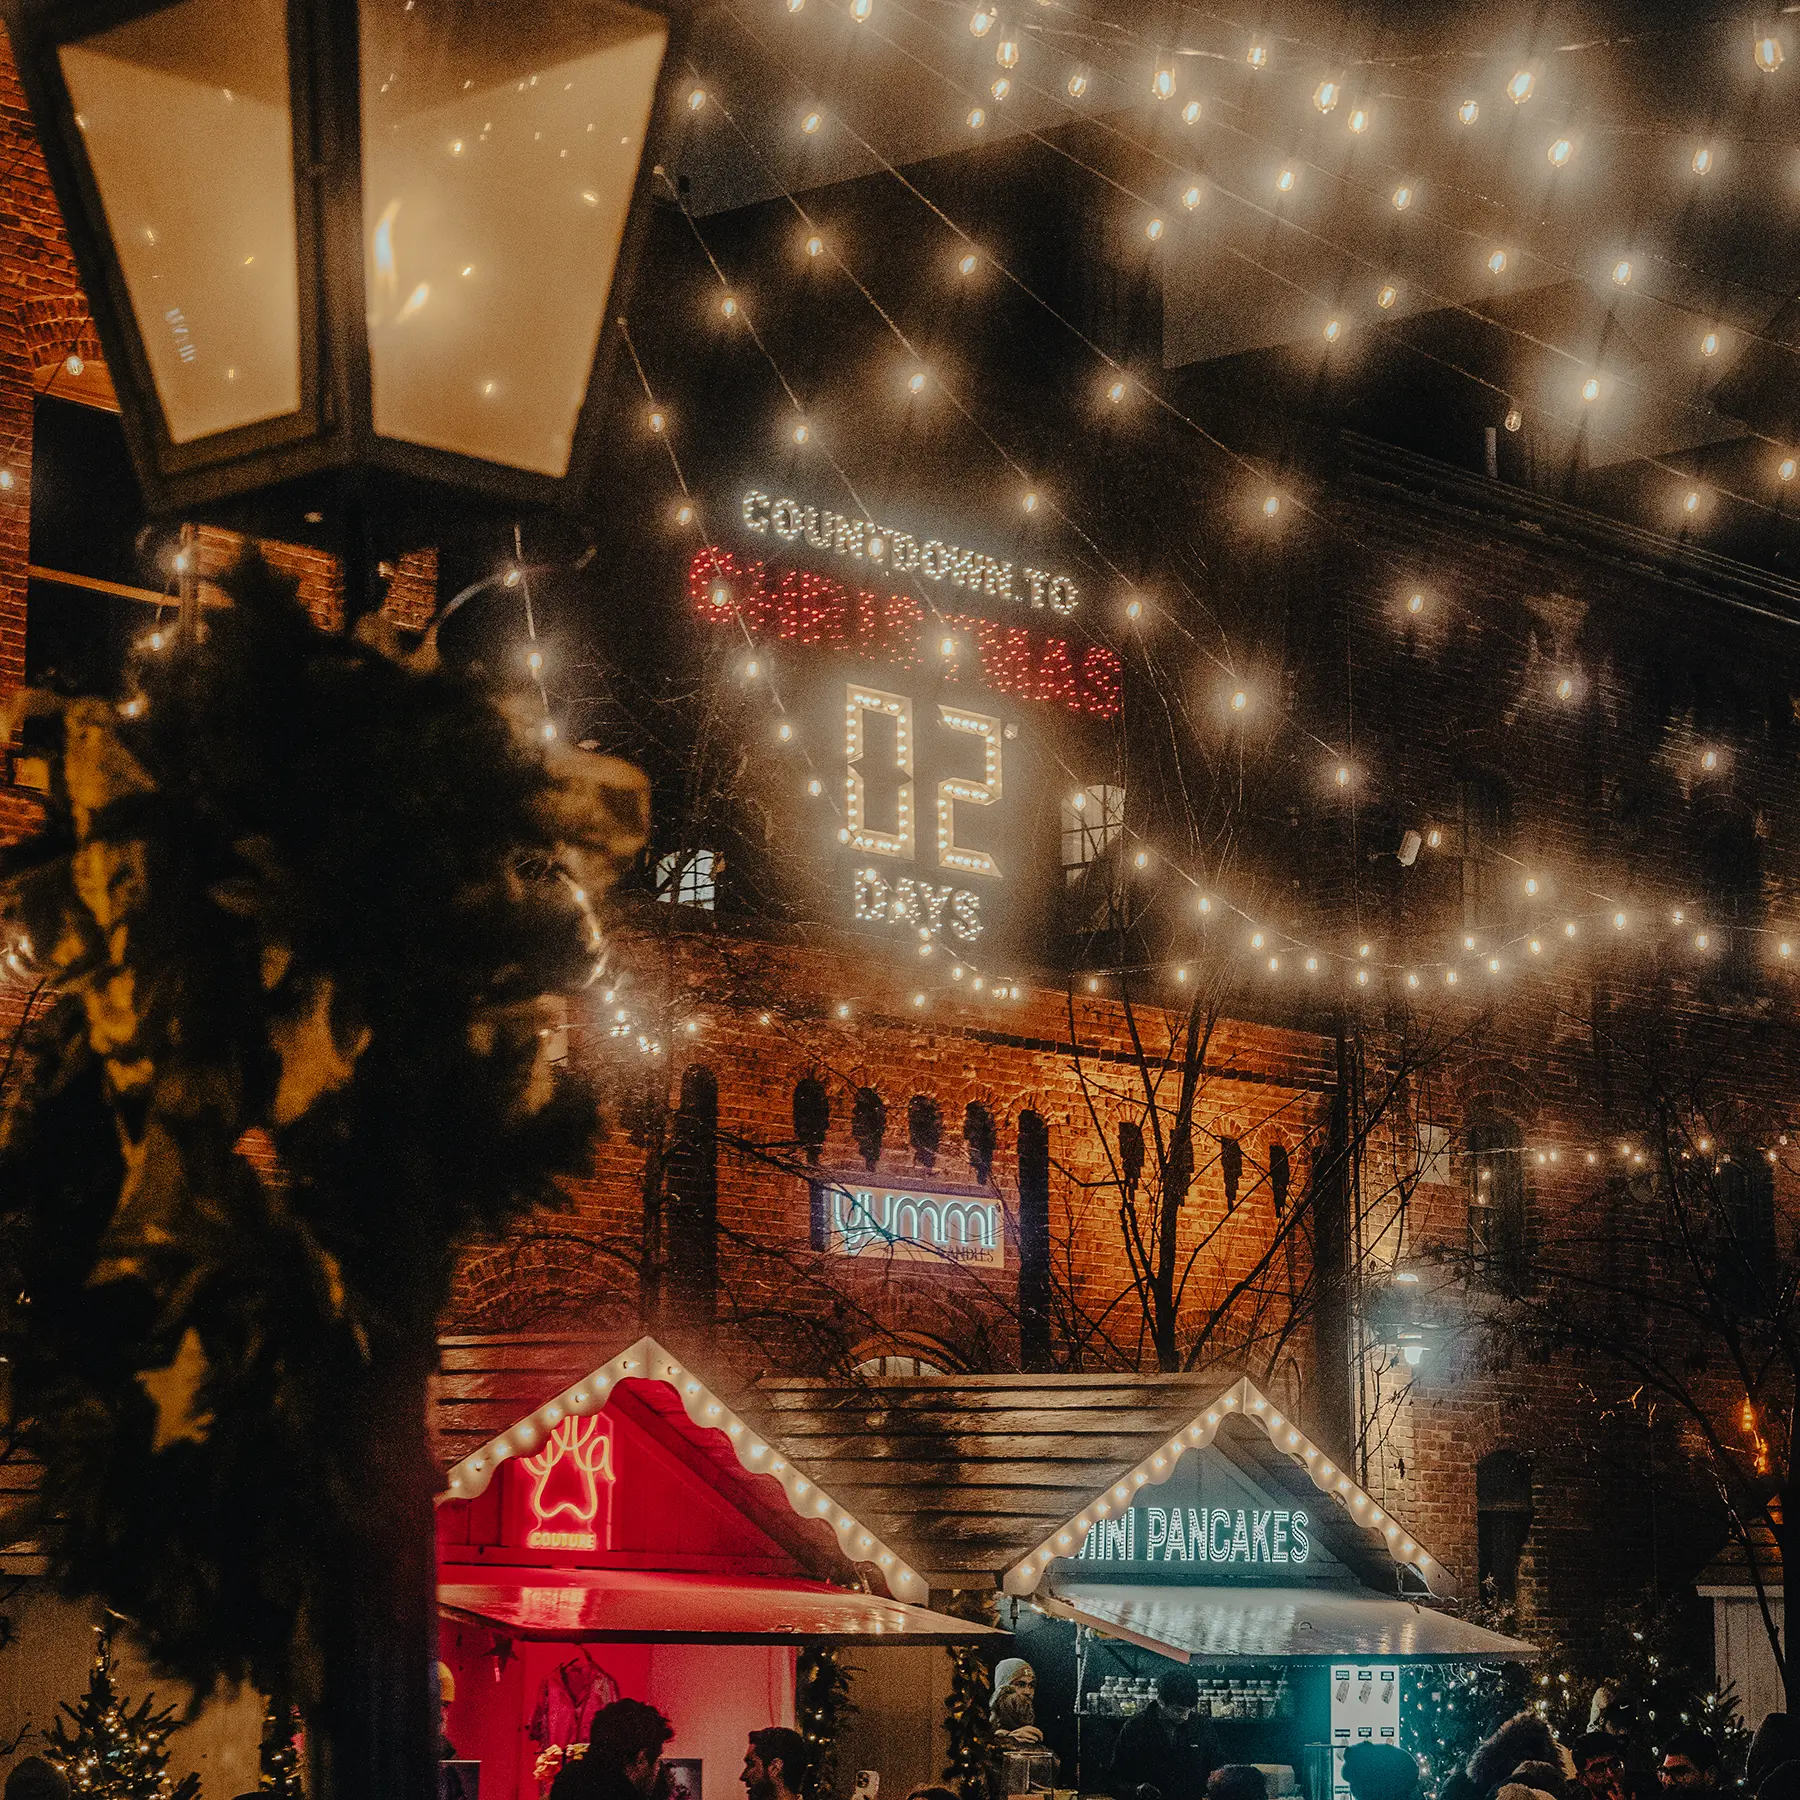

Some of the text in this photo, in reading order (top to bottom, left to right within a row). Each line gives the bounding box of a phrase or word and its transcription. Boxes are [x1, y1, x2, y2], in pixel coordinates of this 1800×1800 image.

[742, 490, 1080, 616] COUNTDOWN TO
[689, 545, 1122, 720] CHRISTMAS
[846, 682, 1003, 878] 02
[854, 868, 984, 942] DAYS
[941, 1244, 995, 1263] ANDLES
[530, 1532, 596, 1549] COUTURE
[1146, 1507, 1310, 1564] PANCAKES
